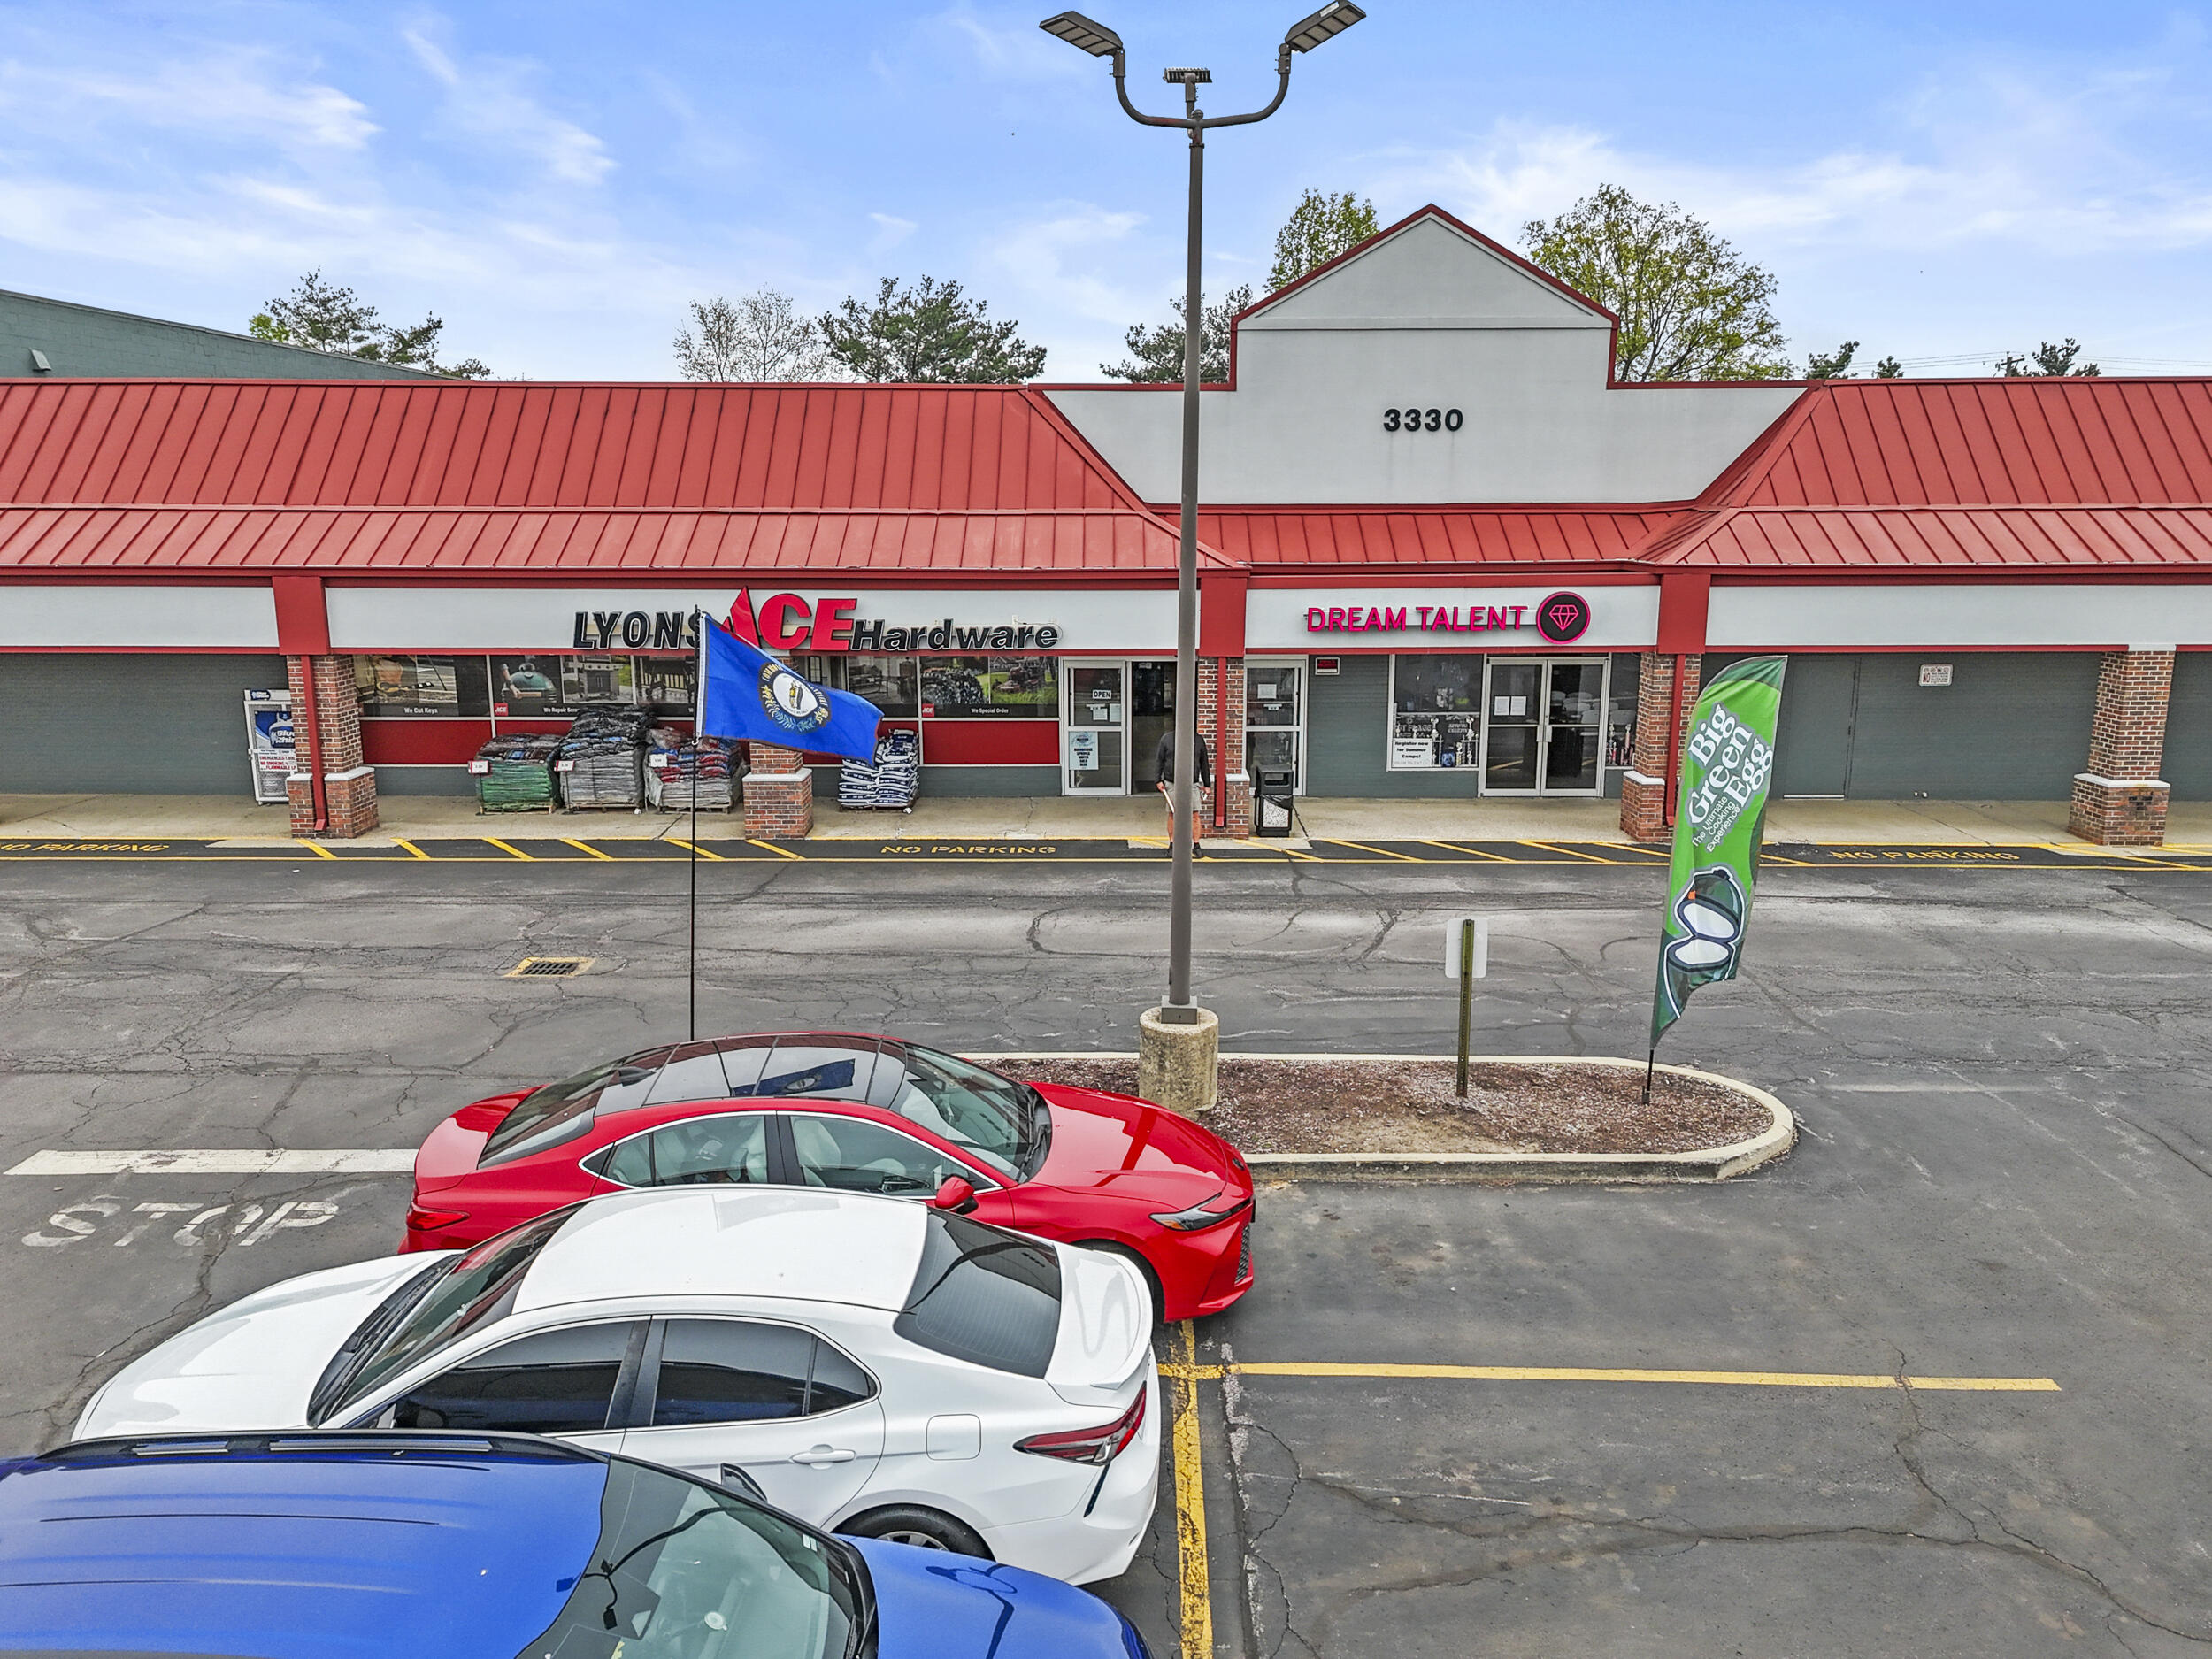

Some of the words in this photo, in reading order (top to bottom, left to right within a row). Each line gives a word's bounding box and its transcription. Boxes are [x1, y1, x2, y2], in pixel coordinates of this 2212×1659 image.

[1383, 408, 1463, 432] 3330
[718, 585, 858, 652] ACE
[850, 618, 1059, 651] Hardware
[1306, 606, 1407, 633] DREAM
[1416, 605, 1528, 632] TALENT
[1687, 703, 1736, 767] Big
[1688, 726, 1753, 824] Green
[1724, 738, 1774, 808] Egg
[1692, 830, 1706, 847] The
[1703, 796, 1728, 830] Ultimate
[1706, 804, 1741, 852] Experience
[1708, 800, 1736, 835] Cooking
[32, 843, 170, 852] PARKING
[1827, 850, 1878, 859] NO
[1881, 849, 2020, 860] PARKING
[21, 1202, 340, 1247] STOP
